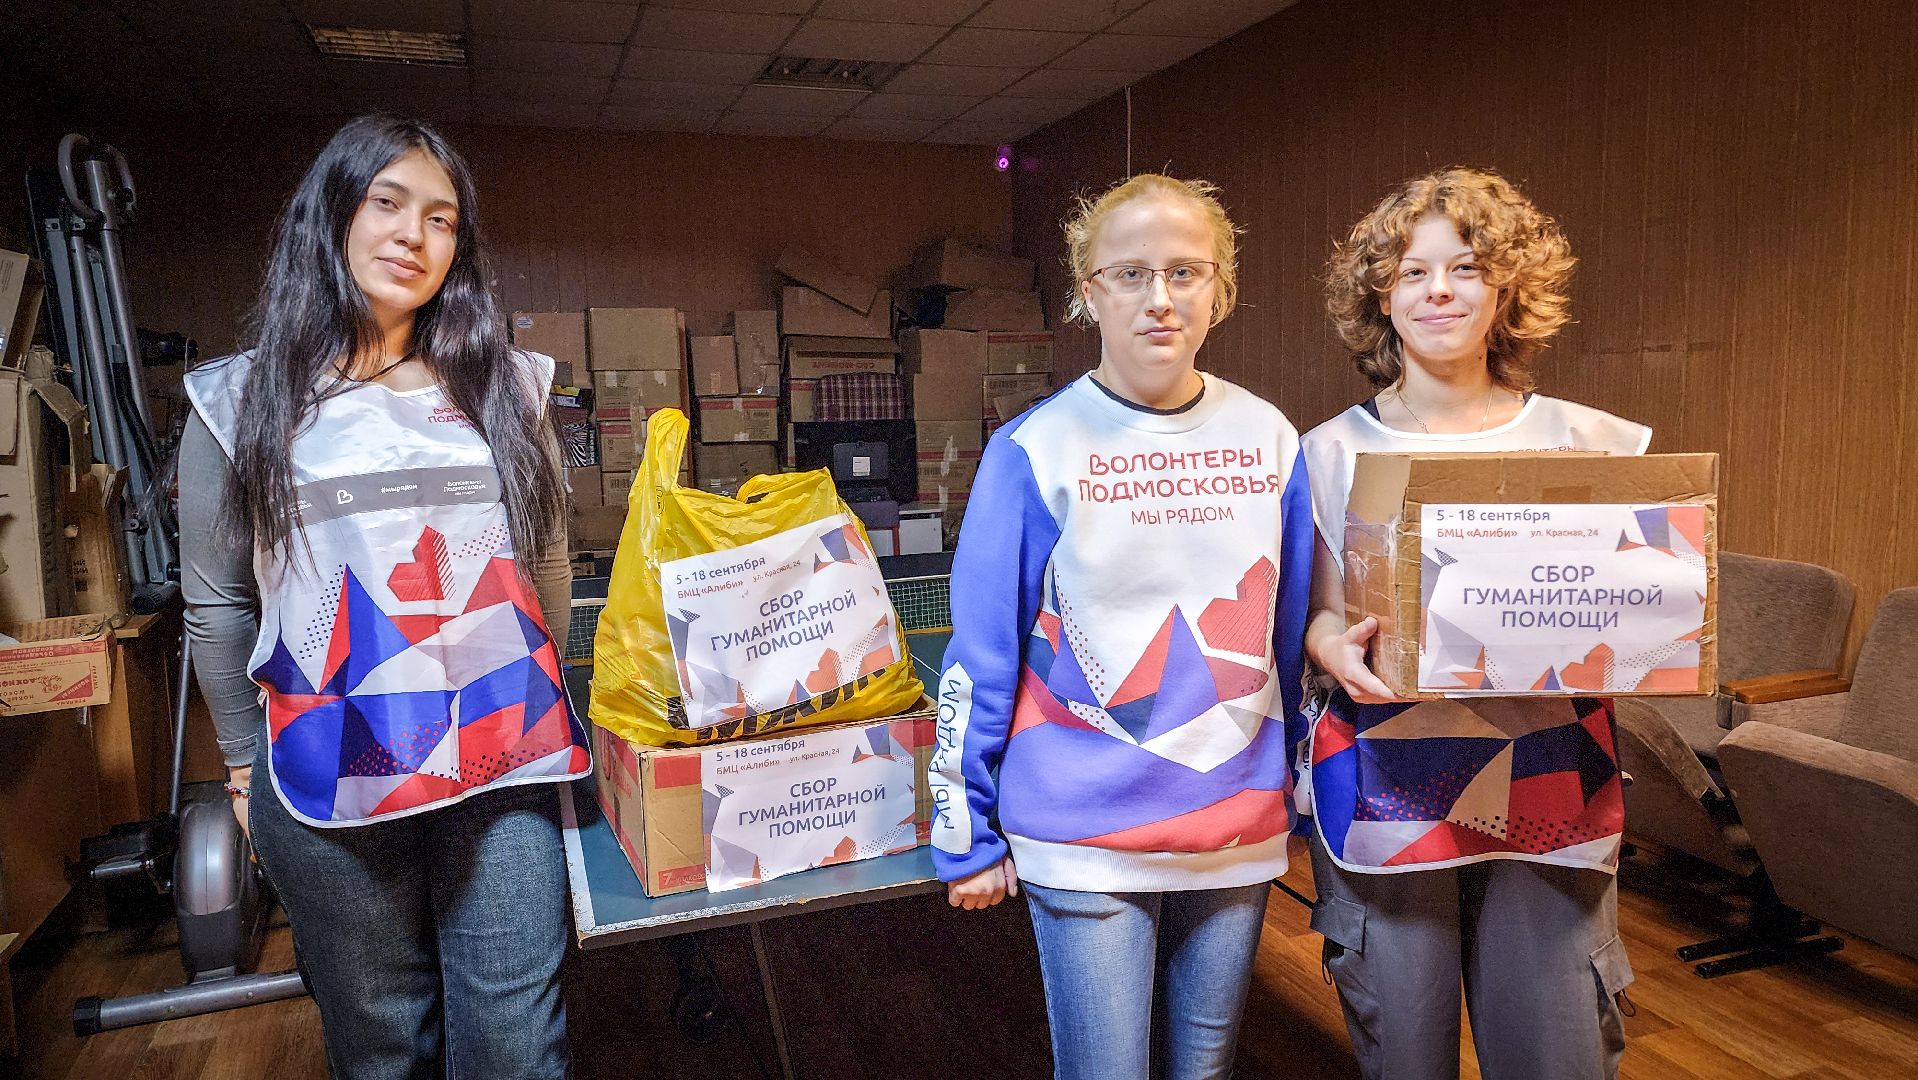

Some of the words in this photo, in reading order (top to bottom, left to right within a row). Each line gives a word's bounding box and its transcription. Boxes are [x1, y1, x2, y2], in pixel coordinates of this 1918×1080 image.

[1090, 448, 1262, 476] ВОЛОНТЕРЫ
[1078, 475, 1280, 503] ПОДМОСКОВЬЯ
[1131, 510, 1161, 525] МЫ
[1166, 506, 1234, 525] РЯДОМ
[1436, 510, 1444, 521] 5
[1459, 510, 1476, 521] 18
[1480, 510, 1550, 524] сентября
[1437, 528, 1464, 539] БМЦ
[1466, 528, 1518, 538] «Алиби»
[1587, 529, 1598, 537] 24
[676, 574, 683, 585] 5
[692, 570, 706, 582] 18
[709, 556, 766, 578] сентября
[677, 586, 700, 600] БМЦ
[700, 580, 744, 596] «Алиби»
[793, 560, 801, 568] 24
[1531, 565, 1595, 583] СБОР
[759, 590, 804, 617] СБОР
[1463, 585, 1663, 606] ГУМАНИТАРНОЙ
[710, 588, 857, 652] ГУМАНИТАРНОЙ
[1502, 611, 1618, 631] ПОМОЩИ
[746, 620, 834, 662] ПОМОЩИ
[716, 752, 724, 762] 5
[733, 748, 747, 759] 18
[750, 739, 806, 756] сентября
[716, 765, 738, 776] БМЦ
[740, 758, 780, 772] «Алиби»
[831, 747, 840, 756] 24
[790, 777, 837, 798] СБОР
[738, 784, 885, 826] ГУМАНИТАРНОЙ
[930, 783, 954, 830] МЫ
[769, 810, 856, 839] ПОМОЩИ
